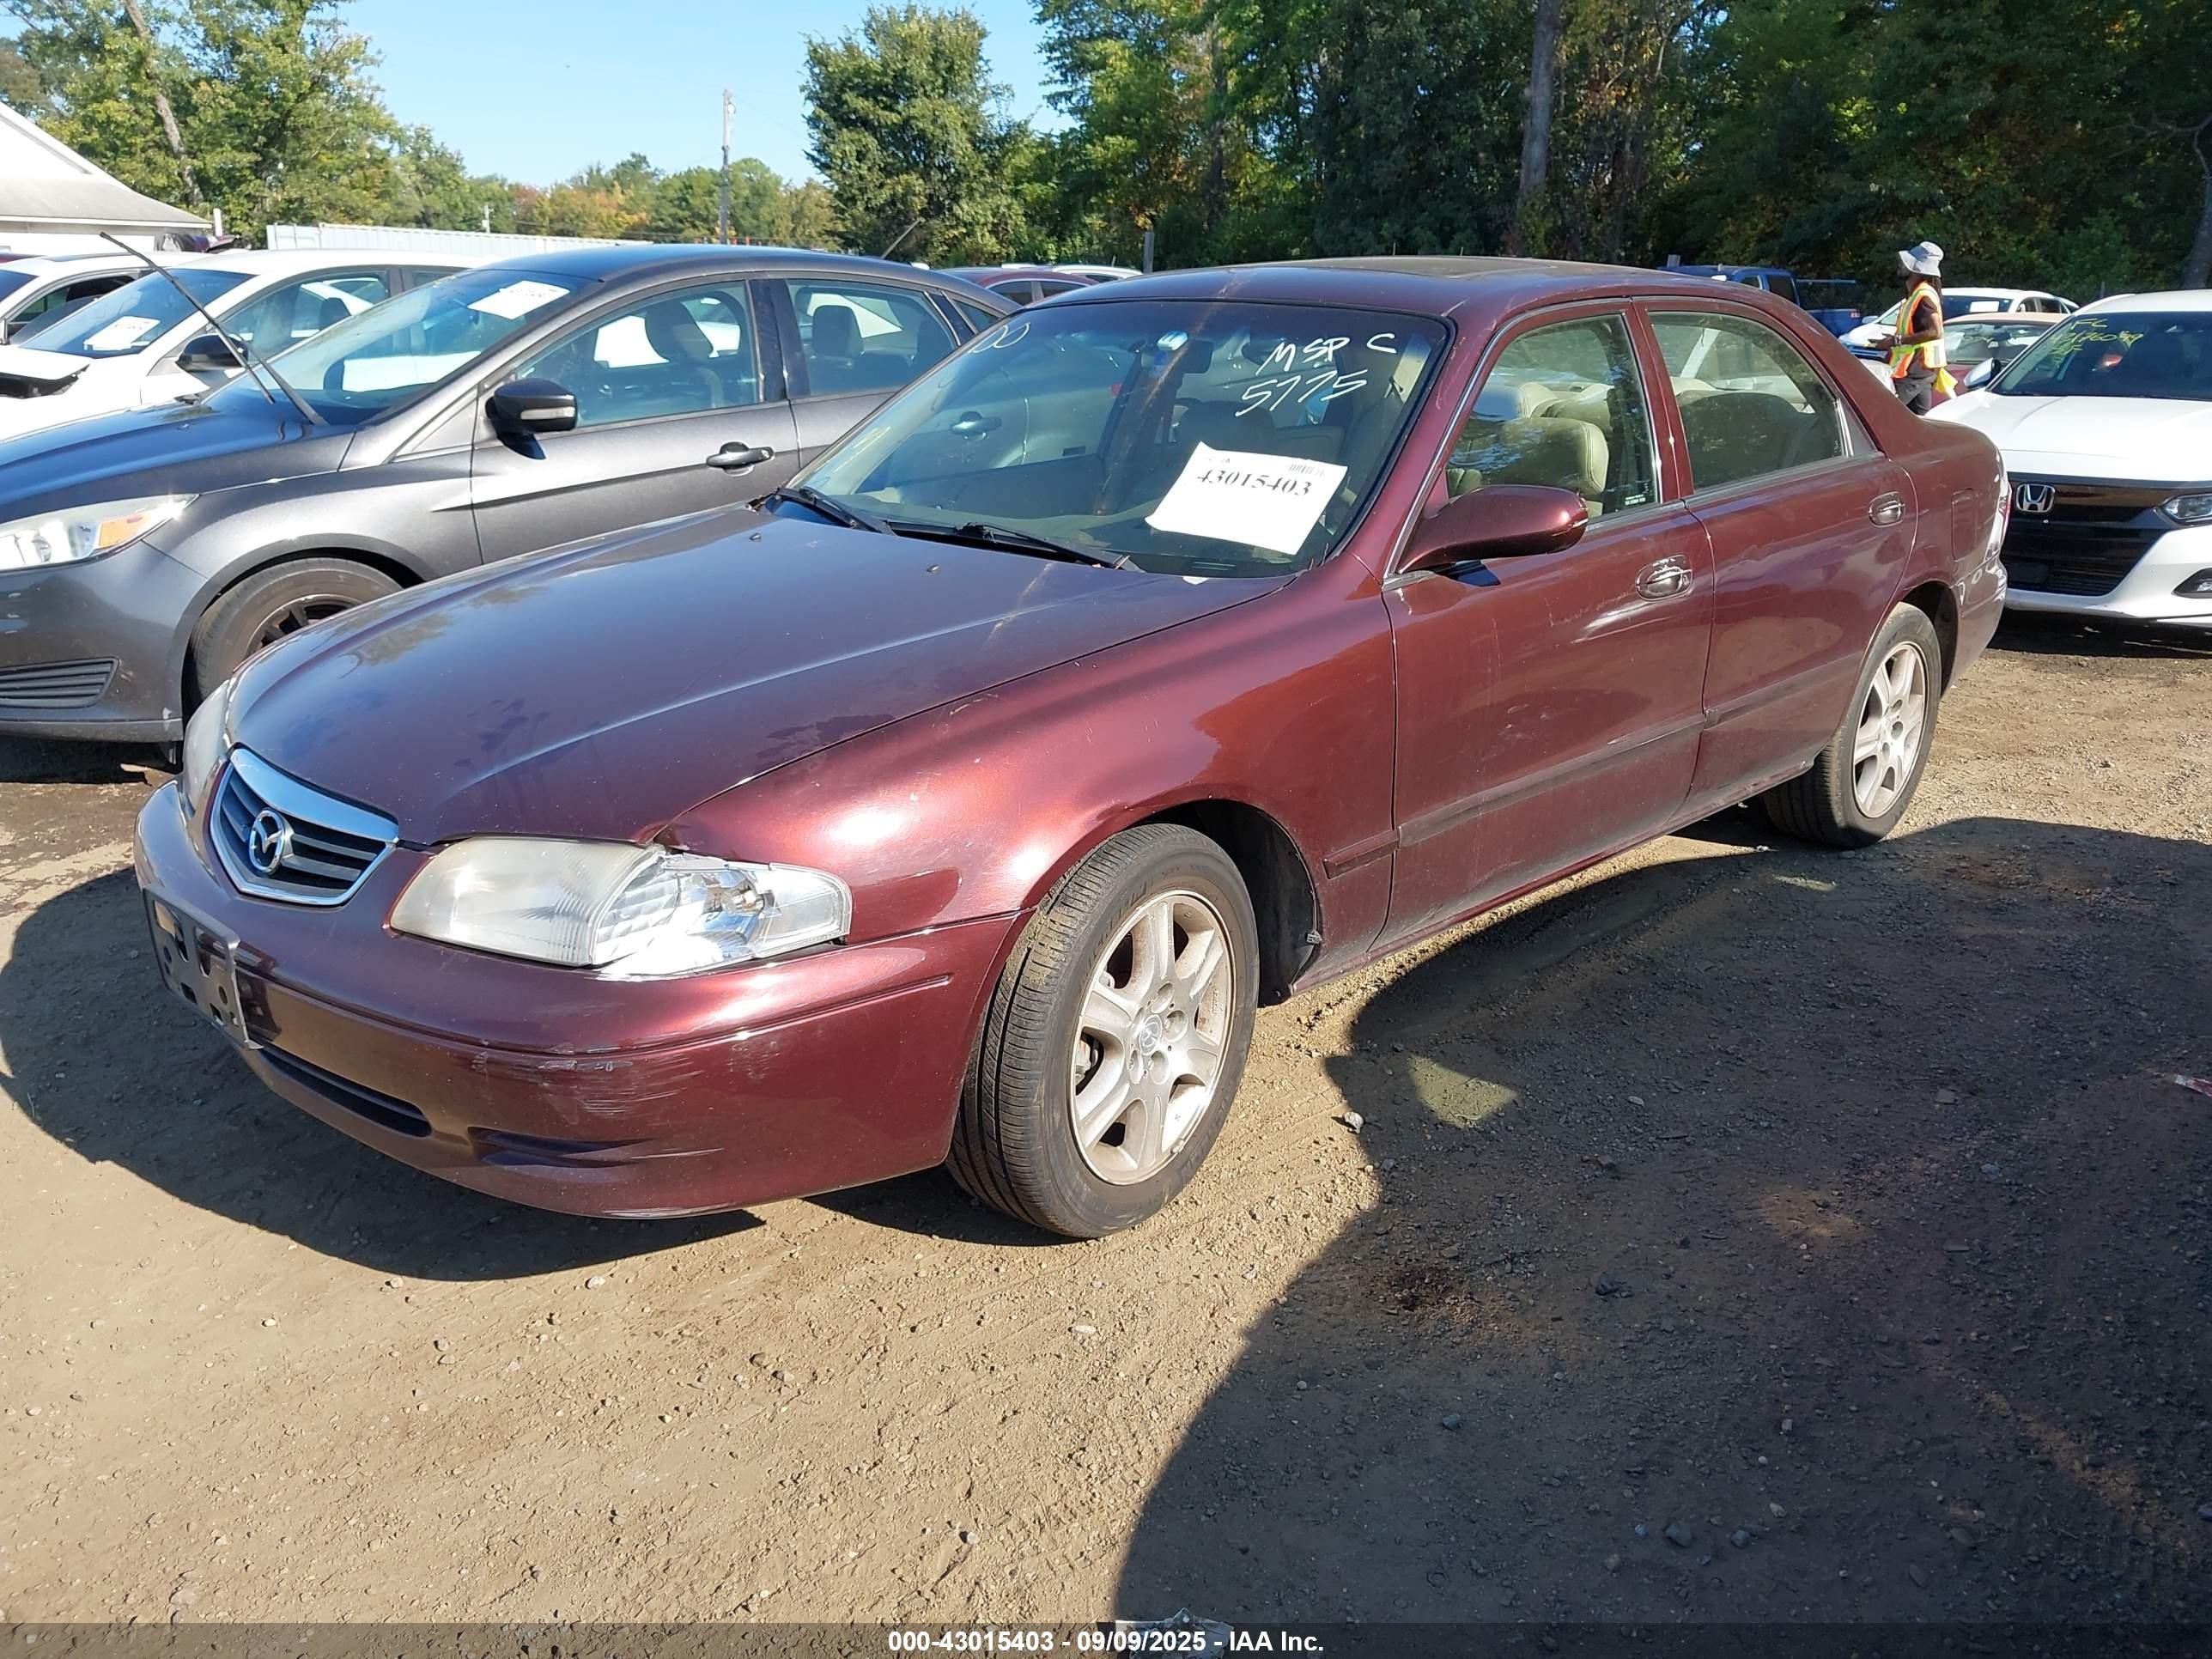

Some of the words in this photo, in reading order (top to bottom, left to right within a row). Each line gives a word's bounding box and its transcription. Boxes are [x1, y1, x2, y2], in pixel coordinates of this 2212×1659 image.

[1366, 332, 1398, 354] C
[1235, 368, 1369, 417] 5775
[1196, 469, 1312, 495] 43015403
